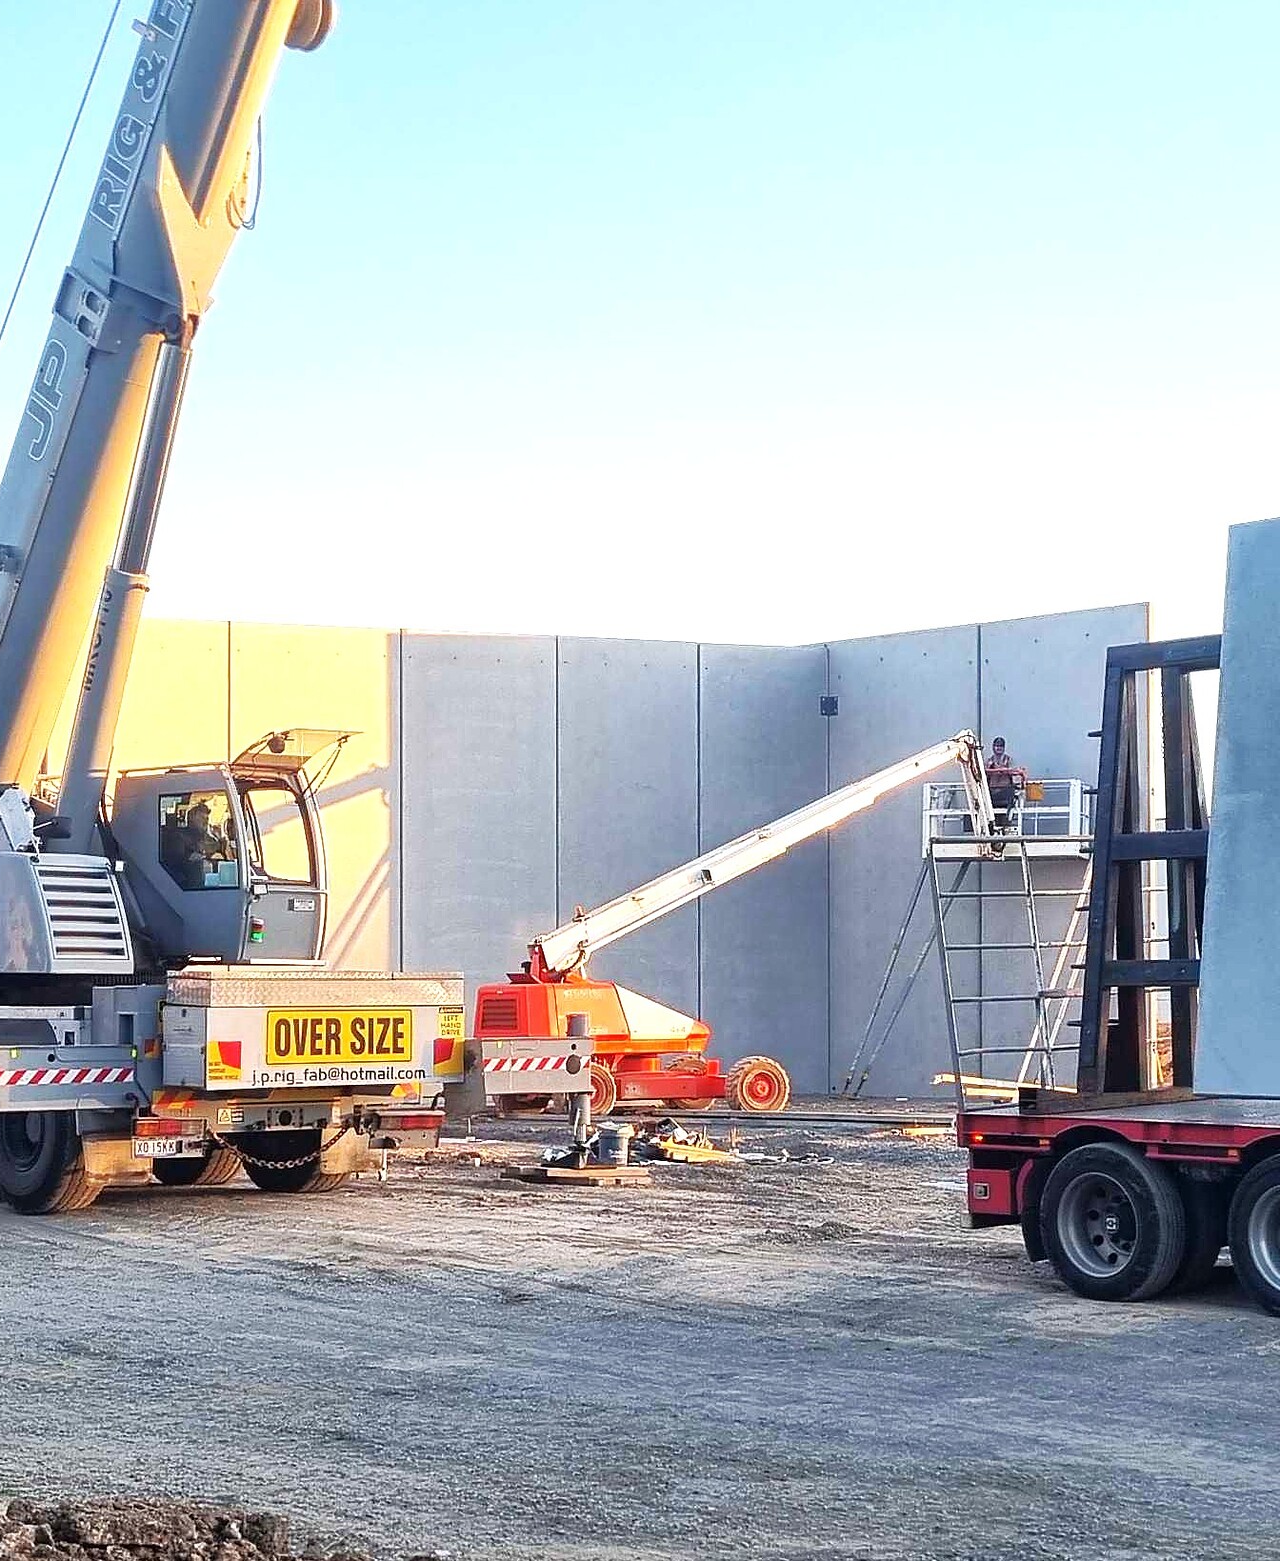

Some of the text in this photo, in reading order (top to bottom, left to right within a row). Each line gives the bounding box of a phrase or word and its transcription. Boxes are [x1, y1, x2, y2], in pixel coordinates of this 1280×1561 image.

[25, 338, 67, 461] JP
[88, 113, 147, 230] RIG
[132, 50, 168, 103] &
[274, 1017, 405, 1057] OVER SIZE
[251, 1067, 426, 1086] j.p.rig_fab@hotmail.com
